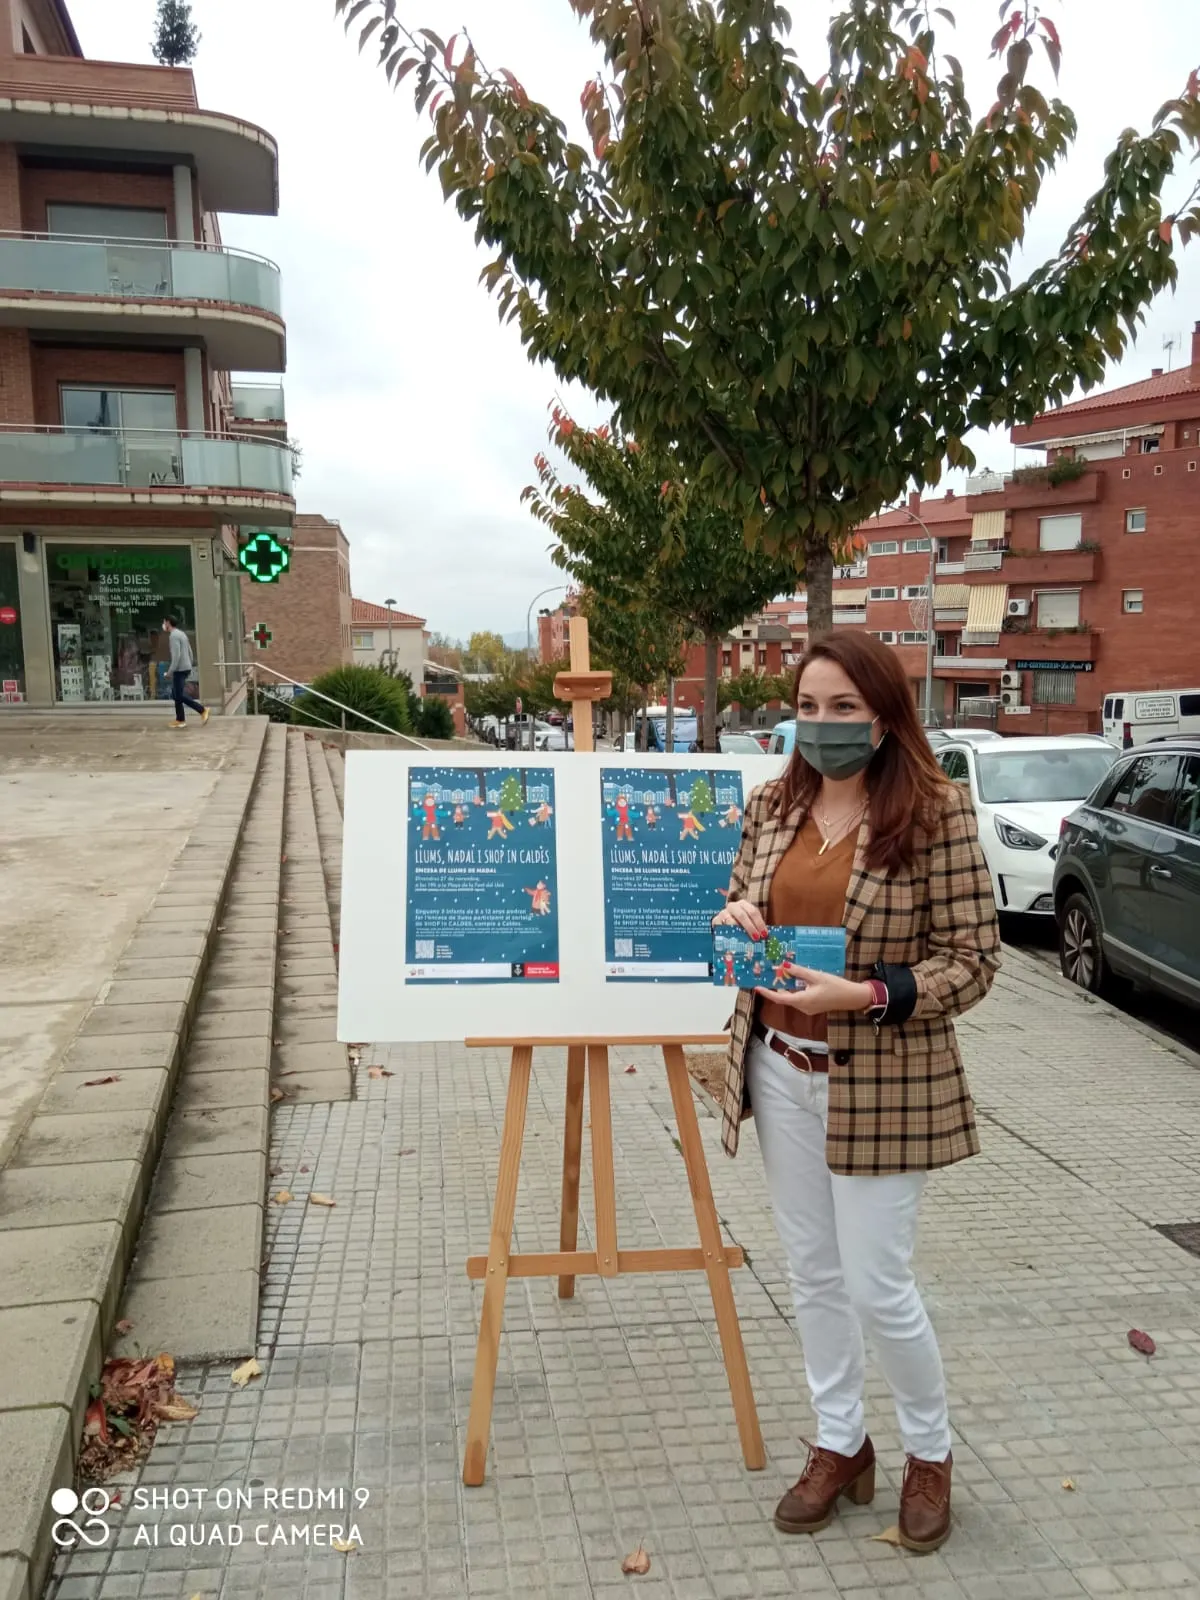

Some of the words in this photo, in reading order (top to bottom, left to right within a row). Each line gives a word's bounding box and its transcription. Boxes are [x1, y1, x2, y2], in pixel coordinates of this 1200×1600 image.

[99, 574, 120, 585] 365
[123, 574, 151, 585] DIES
[415, 849, 445, 865] LLUMS,
[447, 849, 476, 865] NADAL
[484, 849, 505, 865] SHOP
[507, 849, 517, 865] IN
[519, 849, 550, 865] CALDES
[610, 849, 639, 865] LLUMS,
[641, 849, 669, 865] NADAL
[677, 849, 697, 865] SHOP
[699, 849, 709, 865] IN
